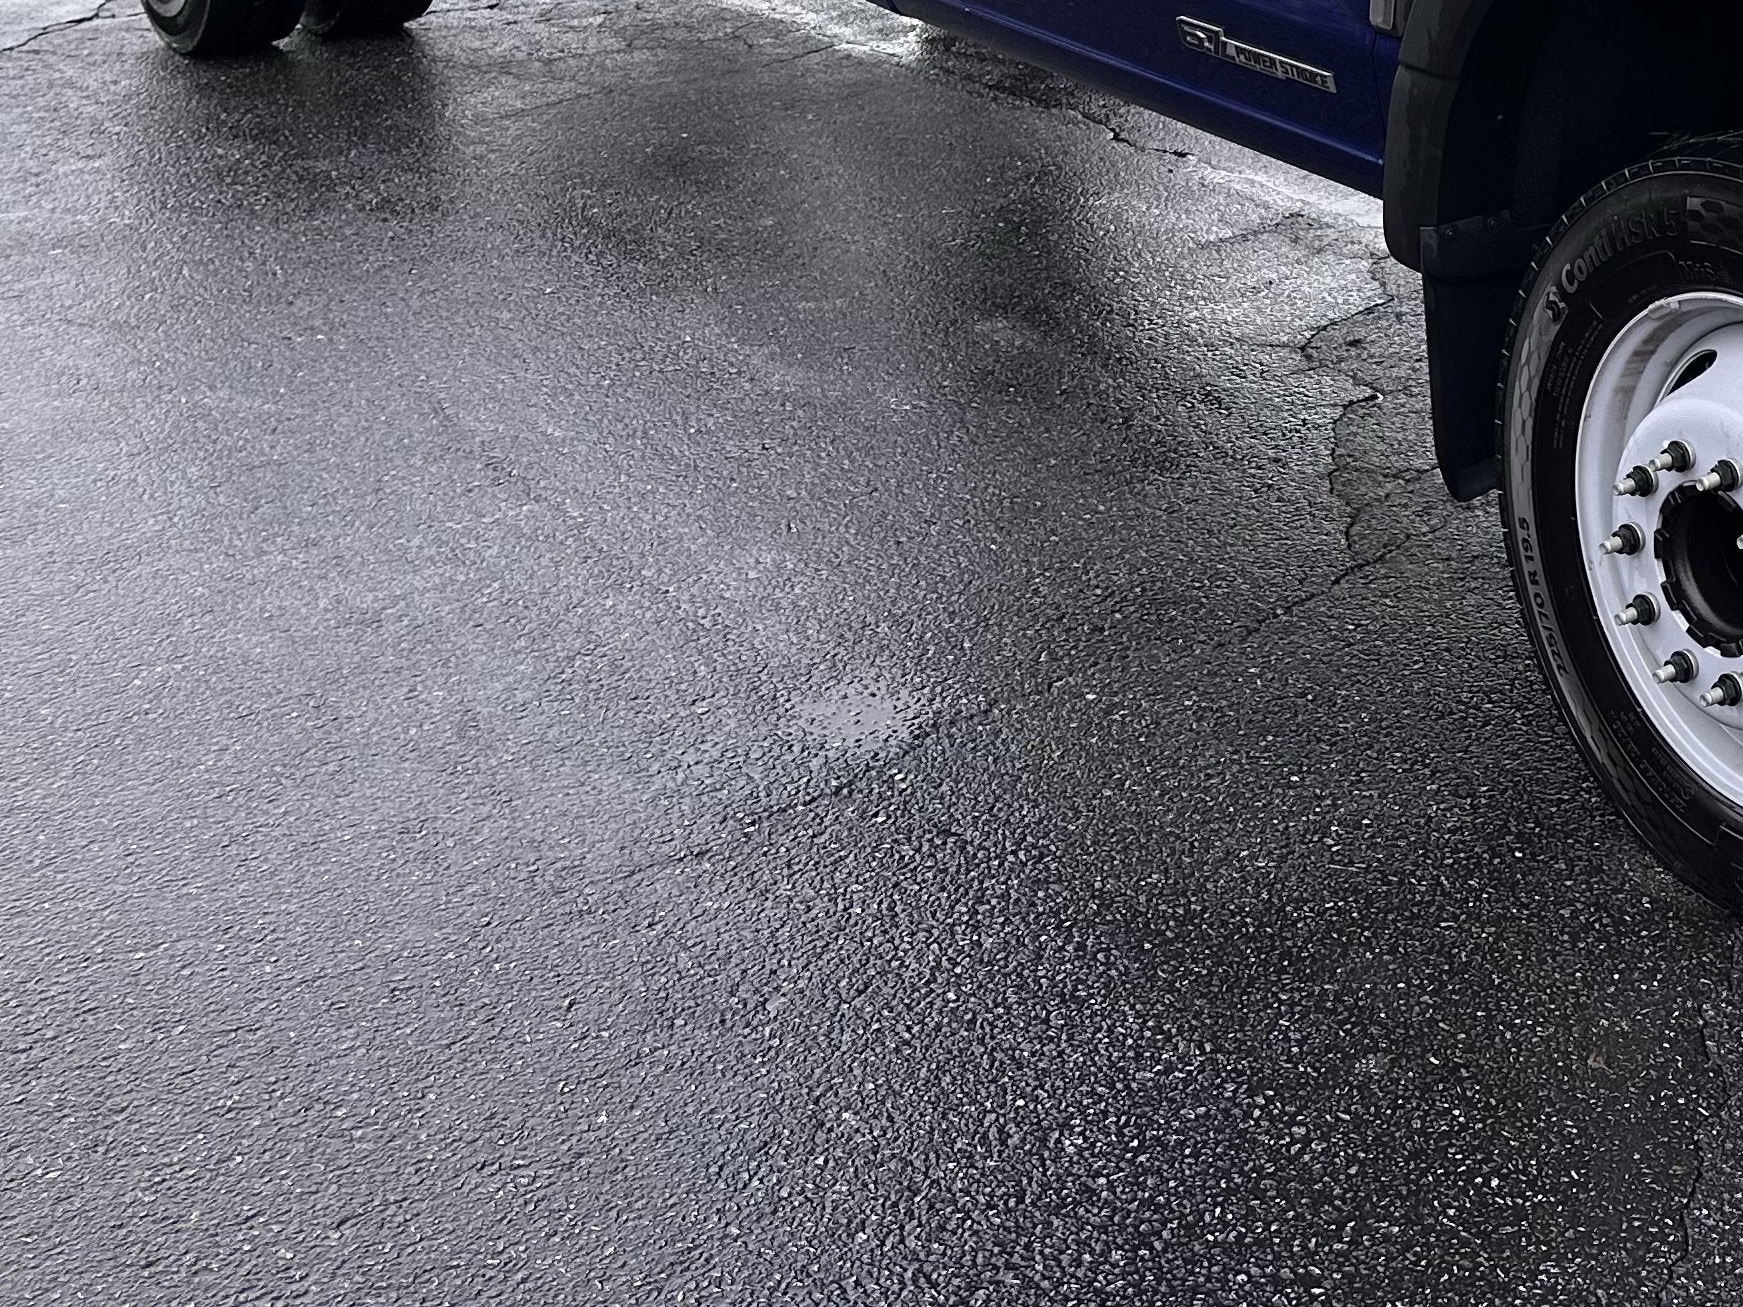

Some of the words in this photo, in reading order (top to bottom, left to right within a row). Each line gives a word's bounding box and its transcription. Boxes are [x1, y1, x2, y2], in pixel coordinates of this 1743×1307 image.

[1561, 231, 1615, 294] Conti
[1518, 516, 1535, 564] 19.5
[1527, 569, 1540, 586] R
[1533, 592, 1570, 678] 225/70
